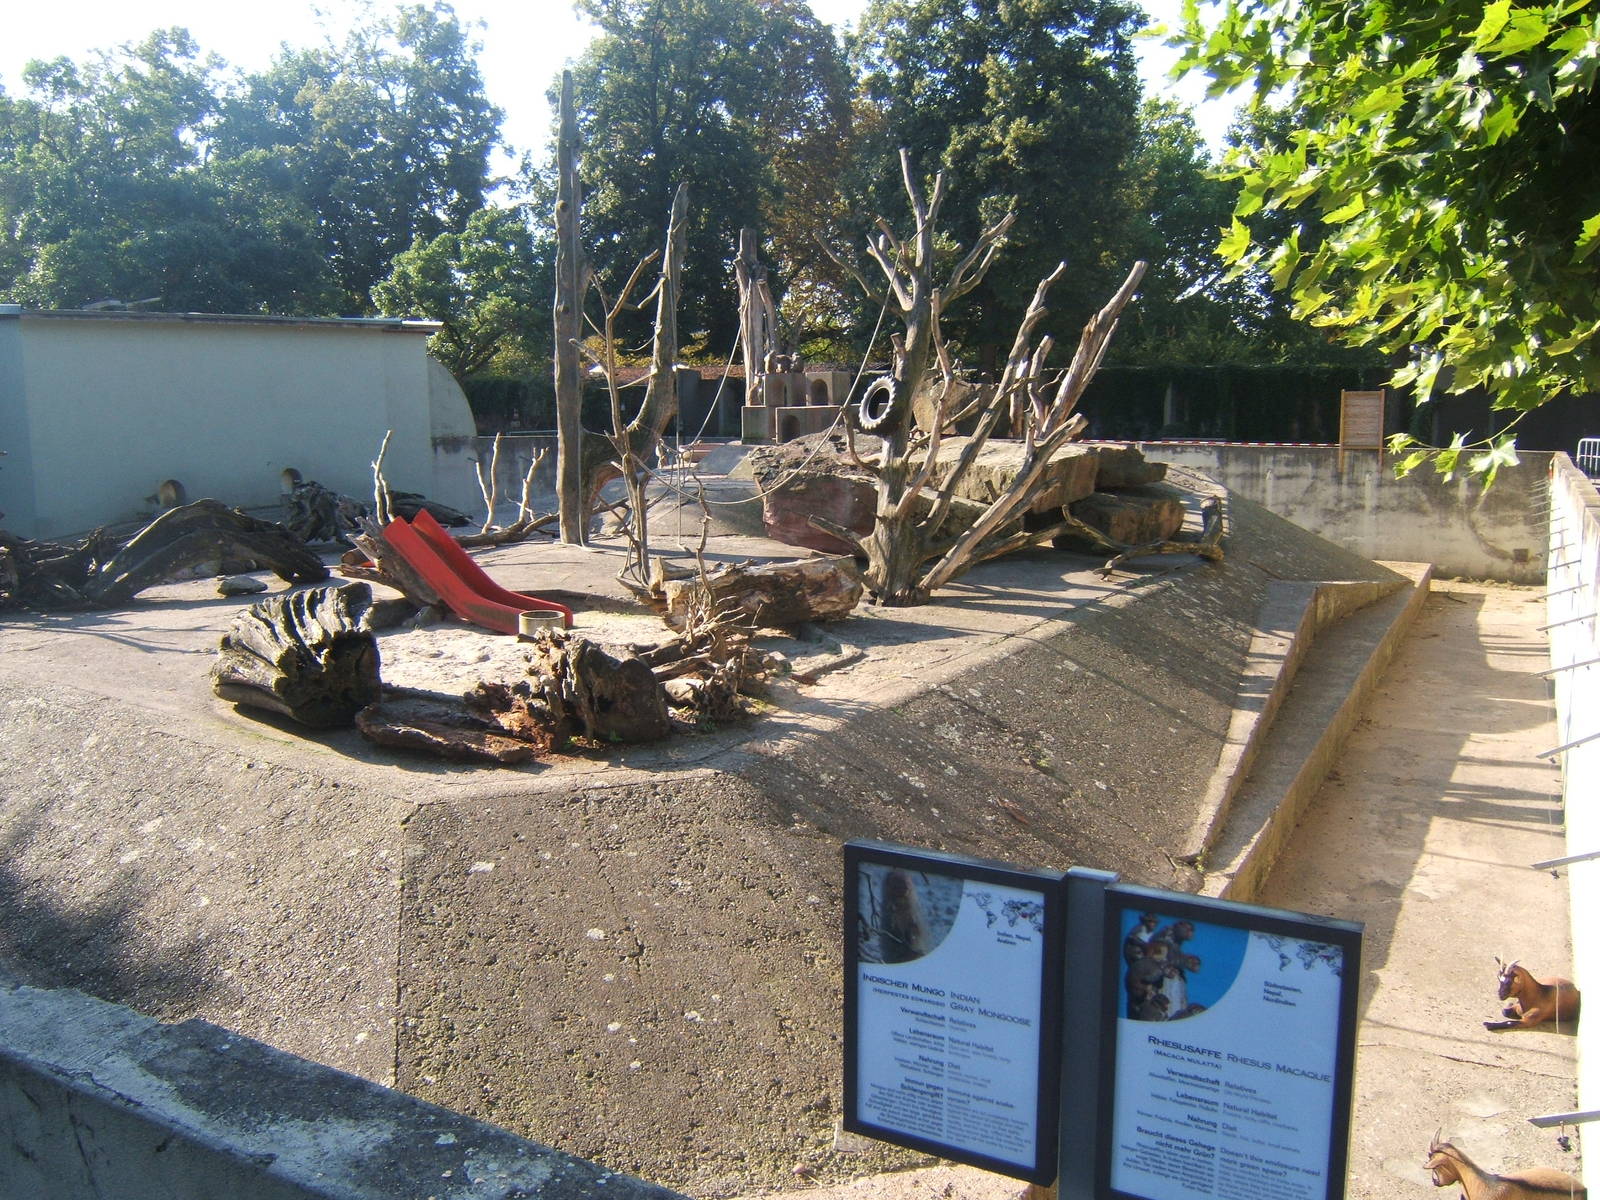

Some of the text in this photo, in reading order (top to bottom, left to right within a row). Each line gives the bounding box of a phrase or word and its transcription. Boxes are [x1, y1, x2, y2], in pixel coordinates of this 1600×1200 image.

[863, 972, 946, 997] INDISCHER MUNGO
[950, 991, 981, 1004] INDIAN
[950, 1001, 1032, 1027] GRAY MONGOOSE
[1148, 1035, 1331, 1083] RHESUSAFFE RHESUS MACAQUE
[1153, 1050, 1185, 1061] (MACACA
[1176, 1091, 1218, 1106] Lebensraum
[1187, 1114, 1218, 1128] Nahrung
